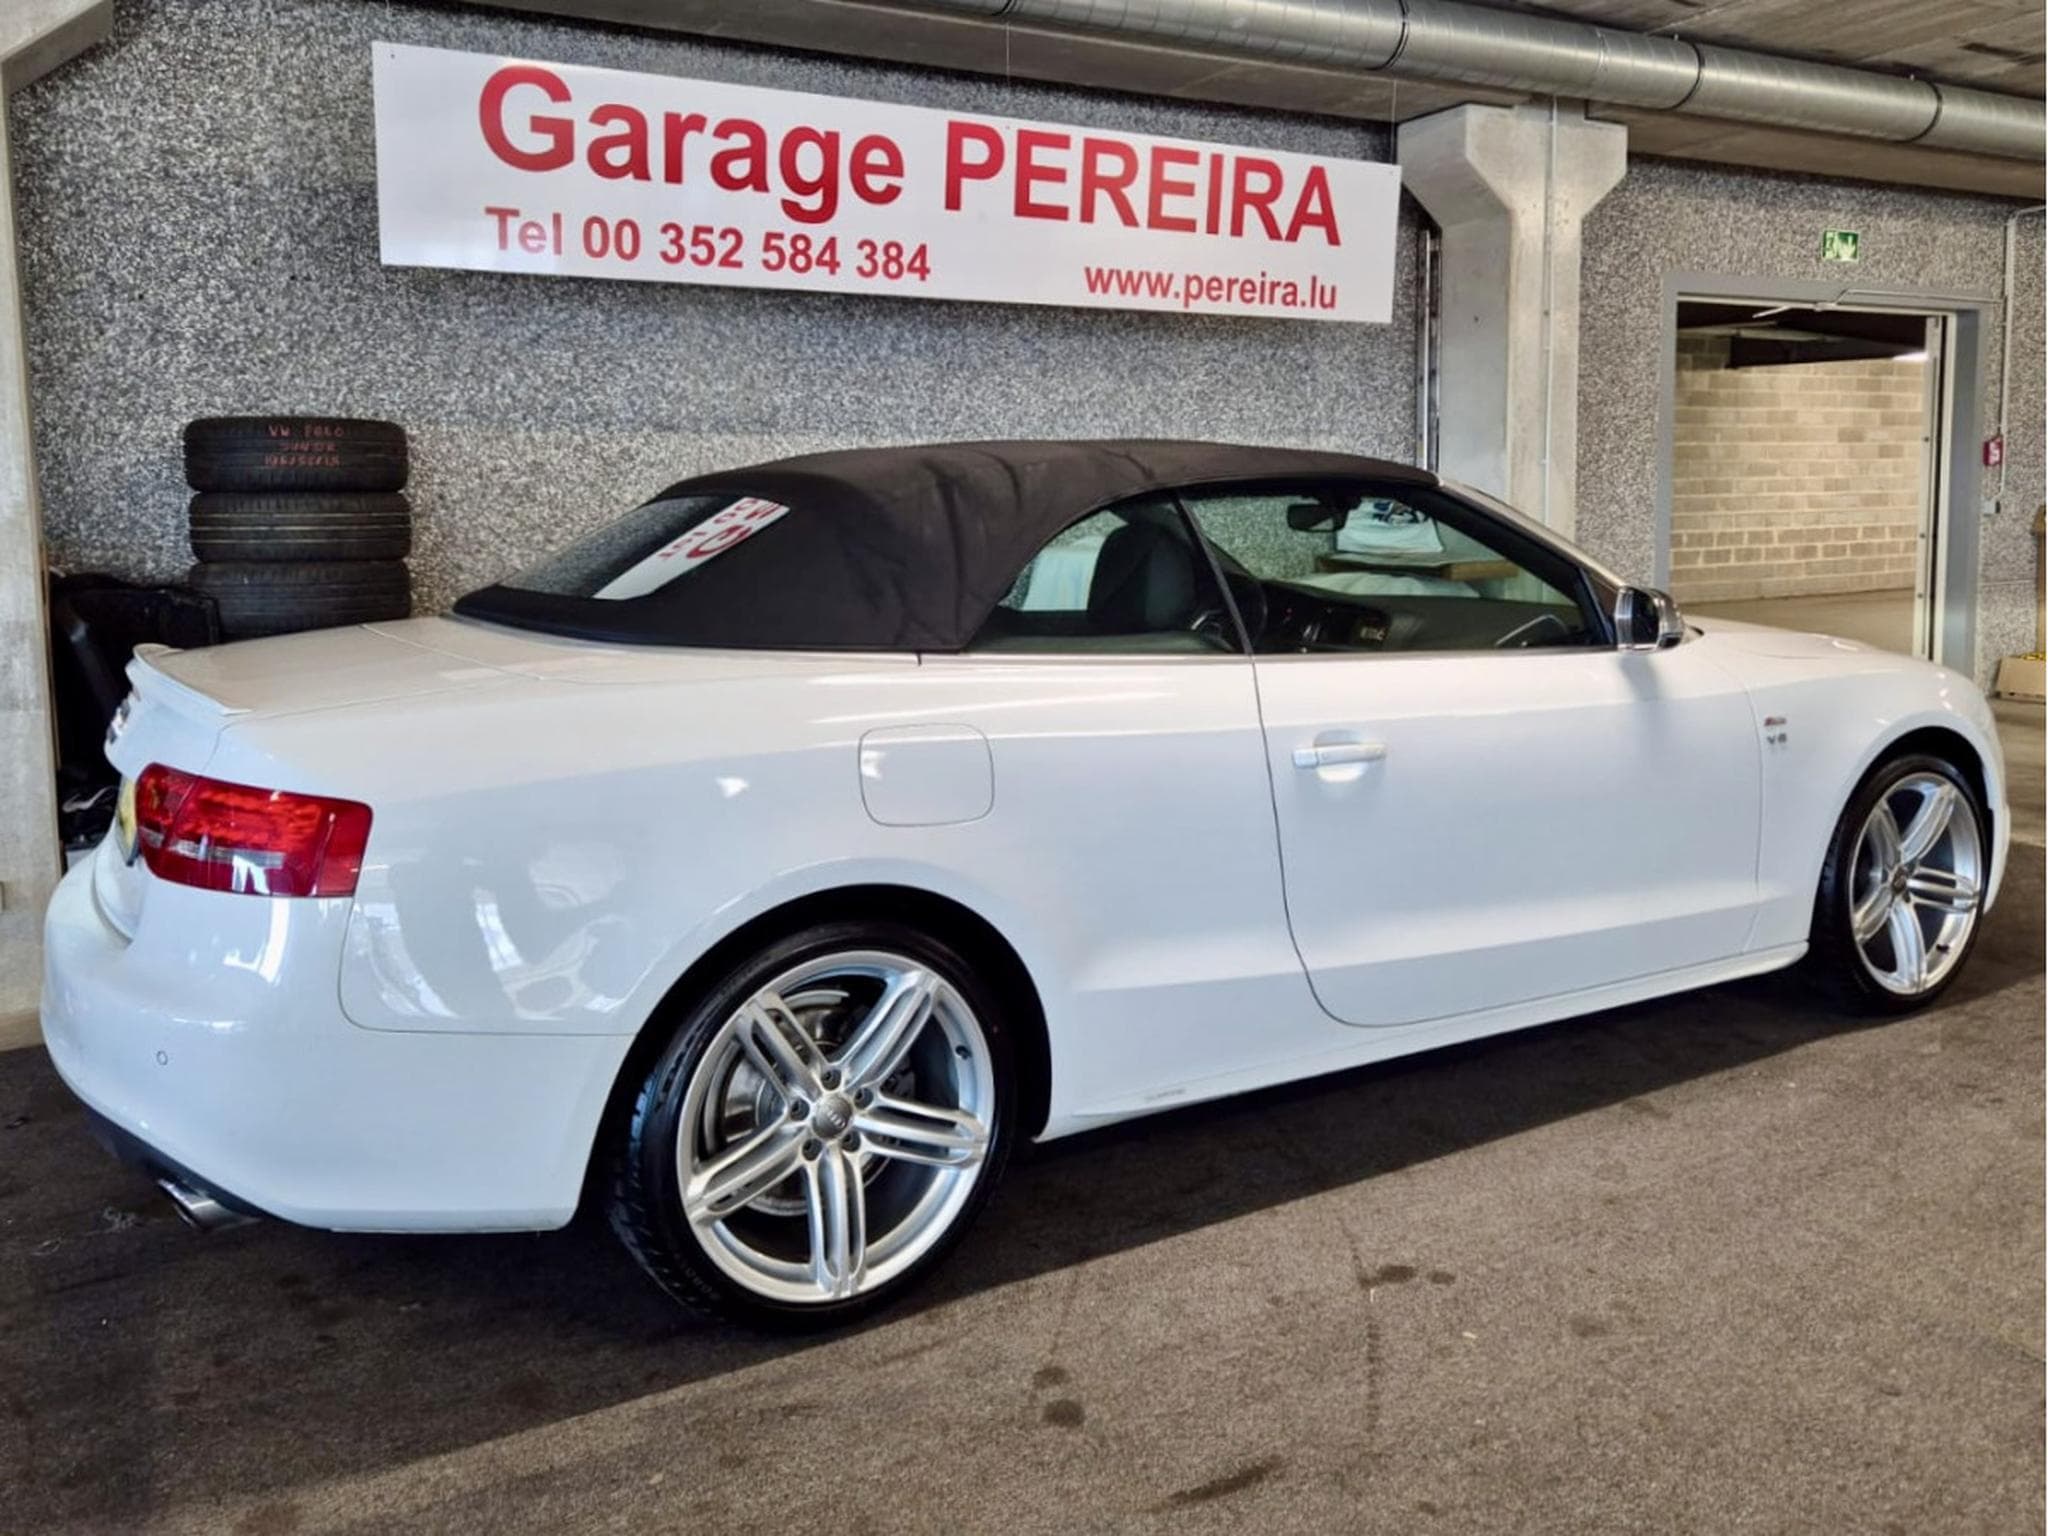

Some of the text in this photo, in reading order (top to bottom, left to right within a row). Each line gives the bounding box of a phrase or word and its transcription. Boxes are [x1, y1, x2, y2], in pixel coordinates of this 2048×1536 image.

[478, 64, 1343, 249] Garage PEREIRA
[484, 205, 932, 283] Tel 00 352 584 384
[1084, 265, 1338, 312] www.pereira.lu
[267, 424, 291, 438] VW
